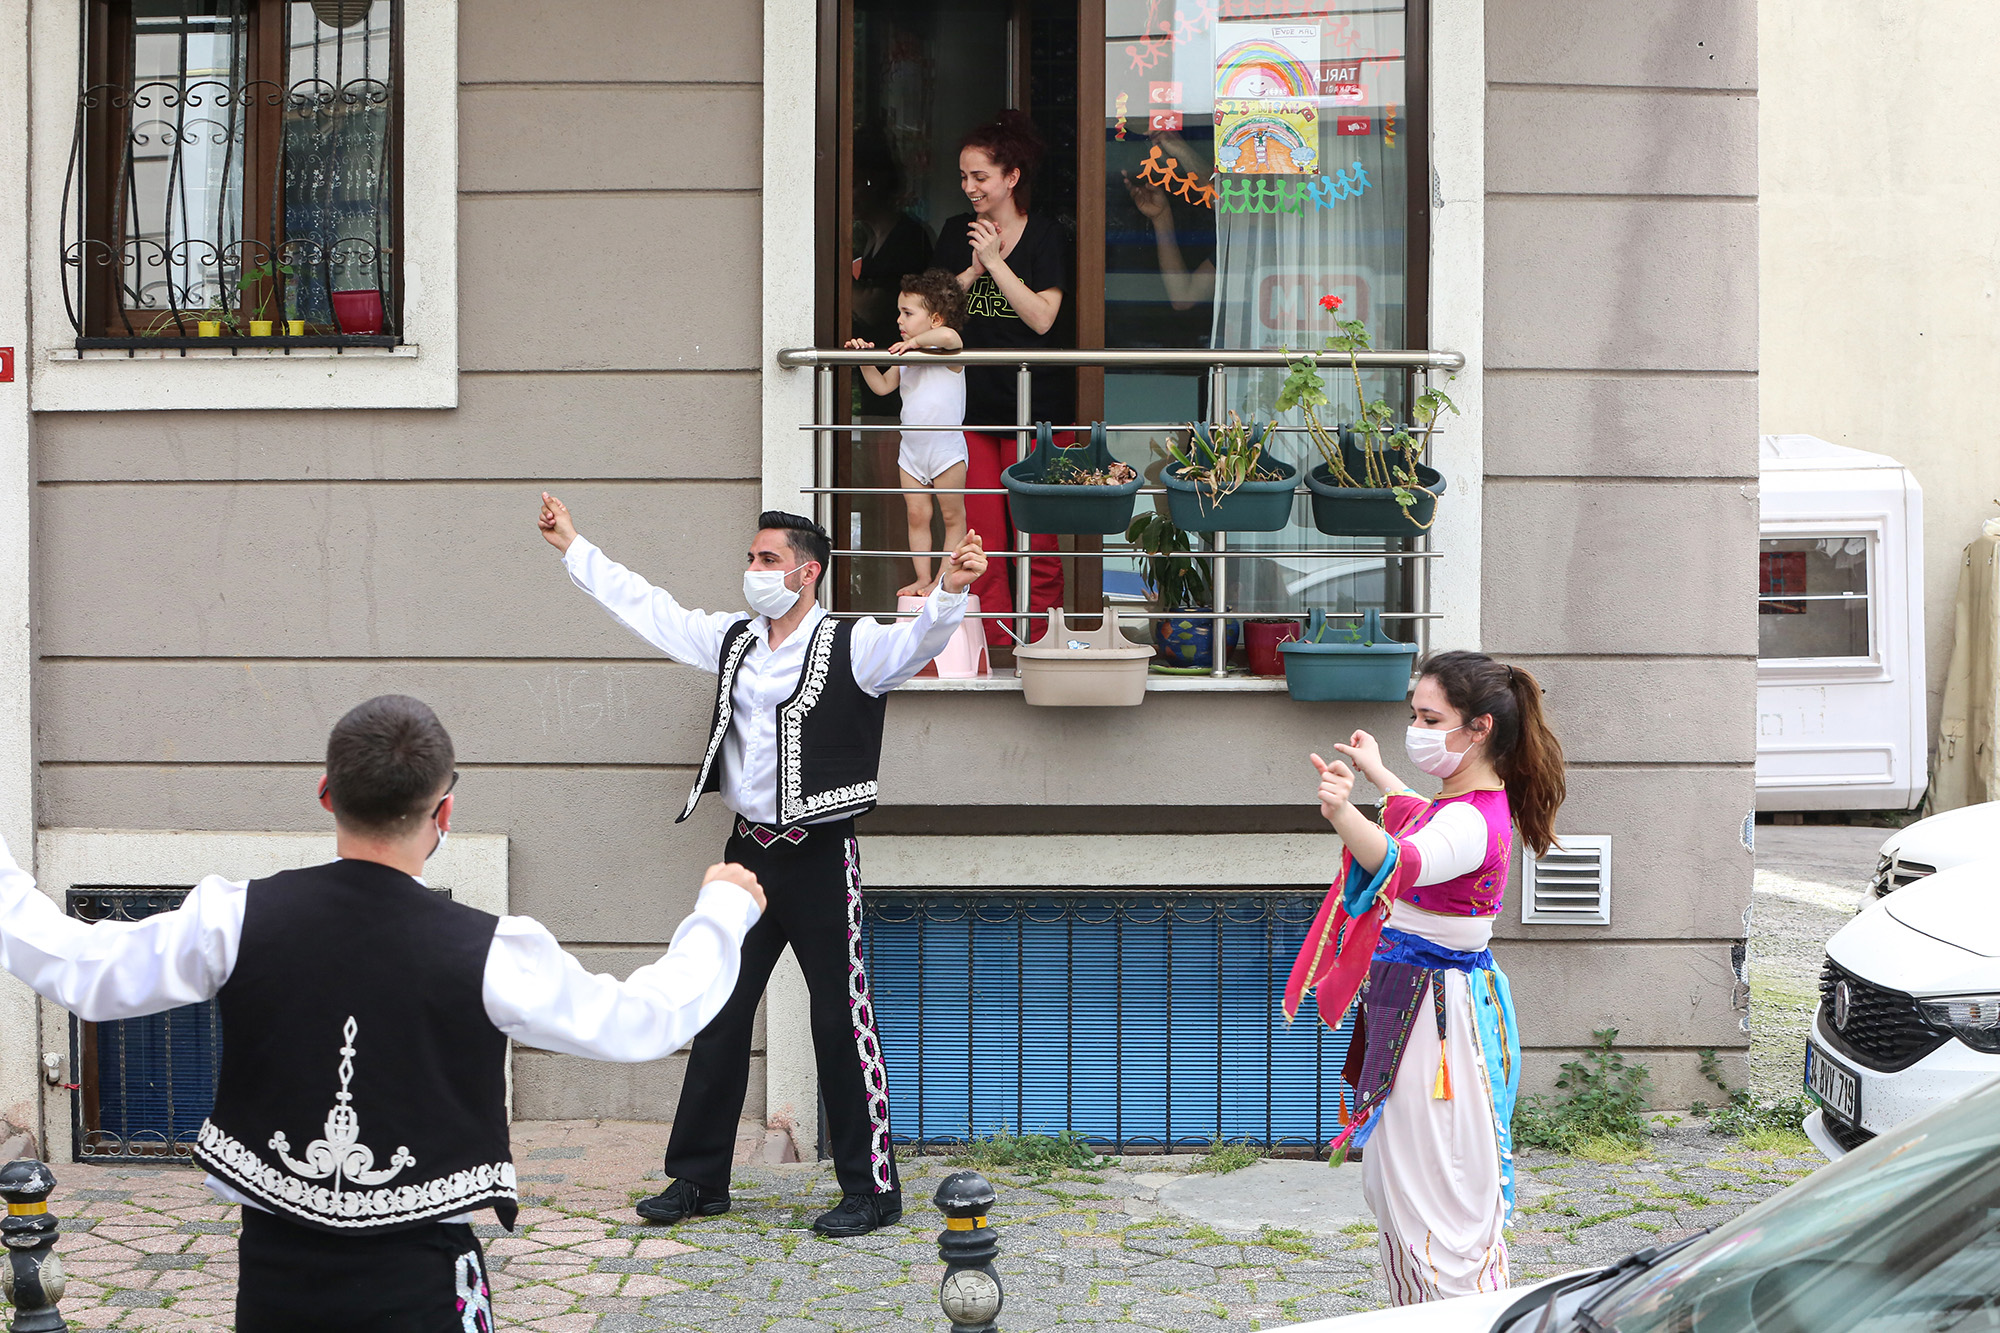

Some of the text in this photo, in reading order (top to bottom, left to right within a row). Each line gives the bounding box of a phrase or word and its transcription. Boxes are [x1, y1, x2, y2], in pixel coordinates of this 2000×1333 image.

[1275, 28, 1295, 36] EVDE
[1226, 101, 1250, 116] 23
[1838, 1072, 1854, 1115] 719
